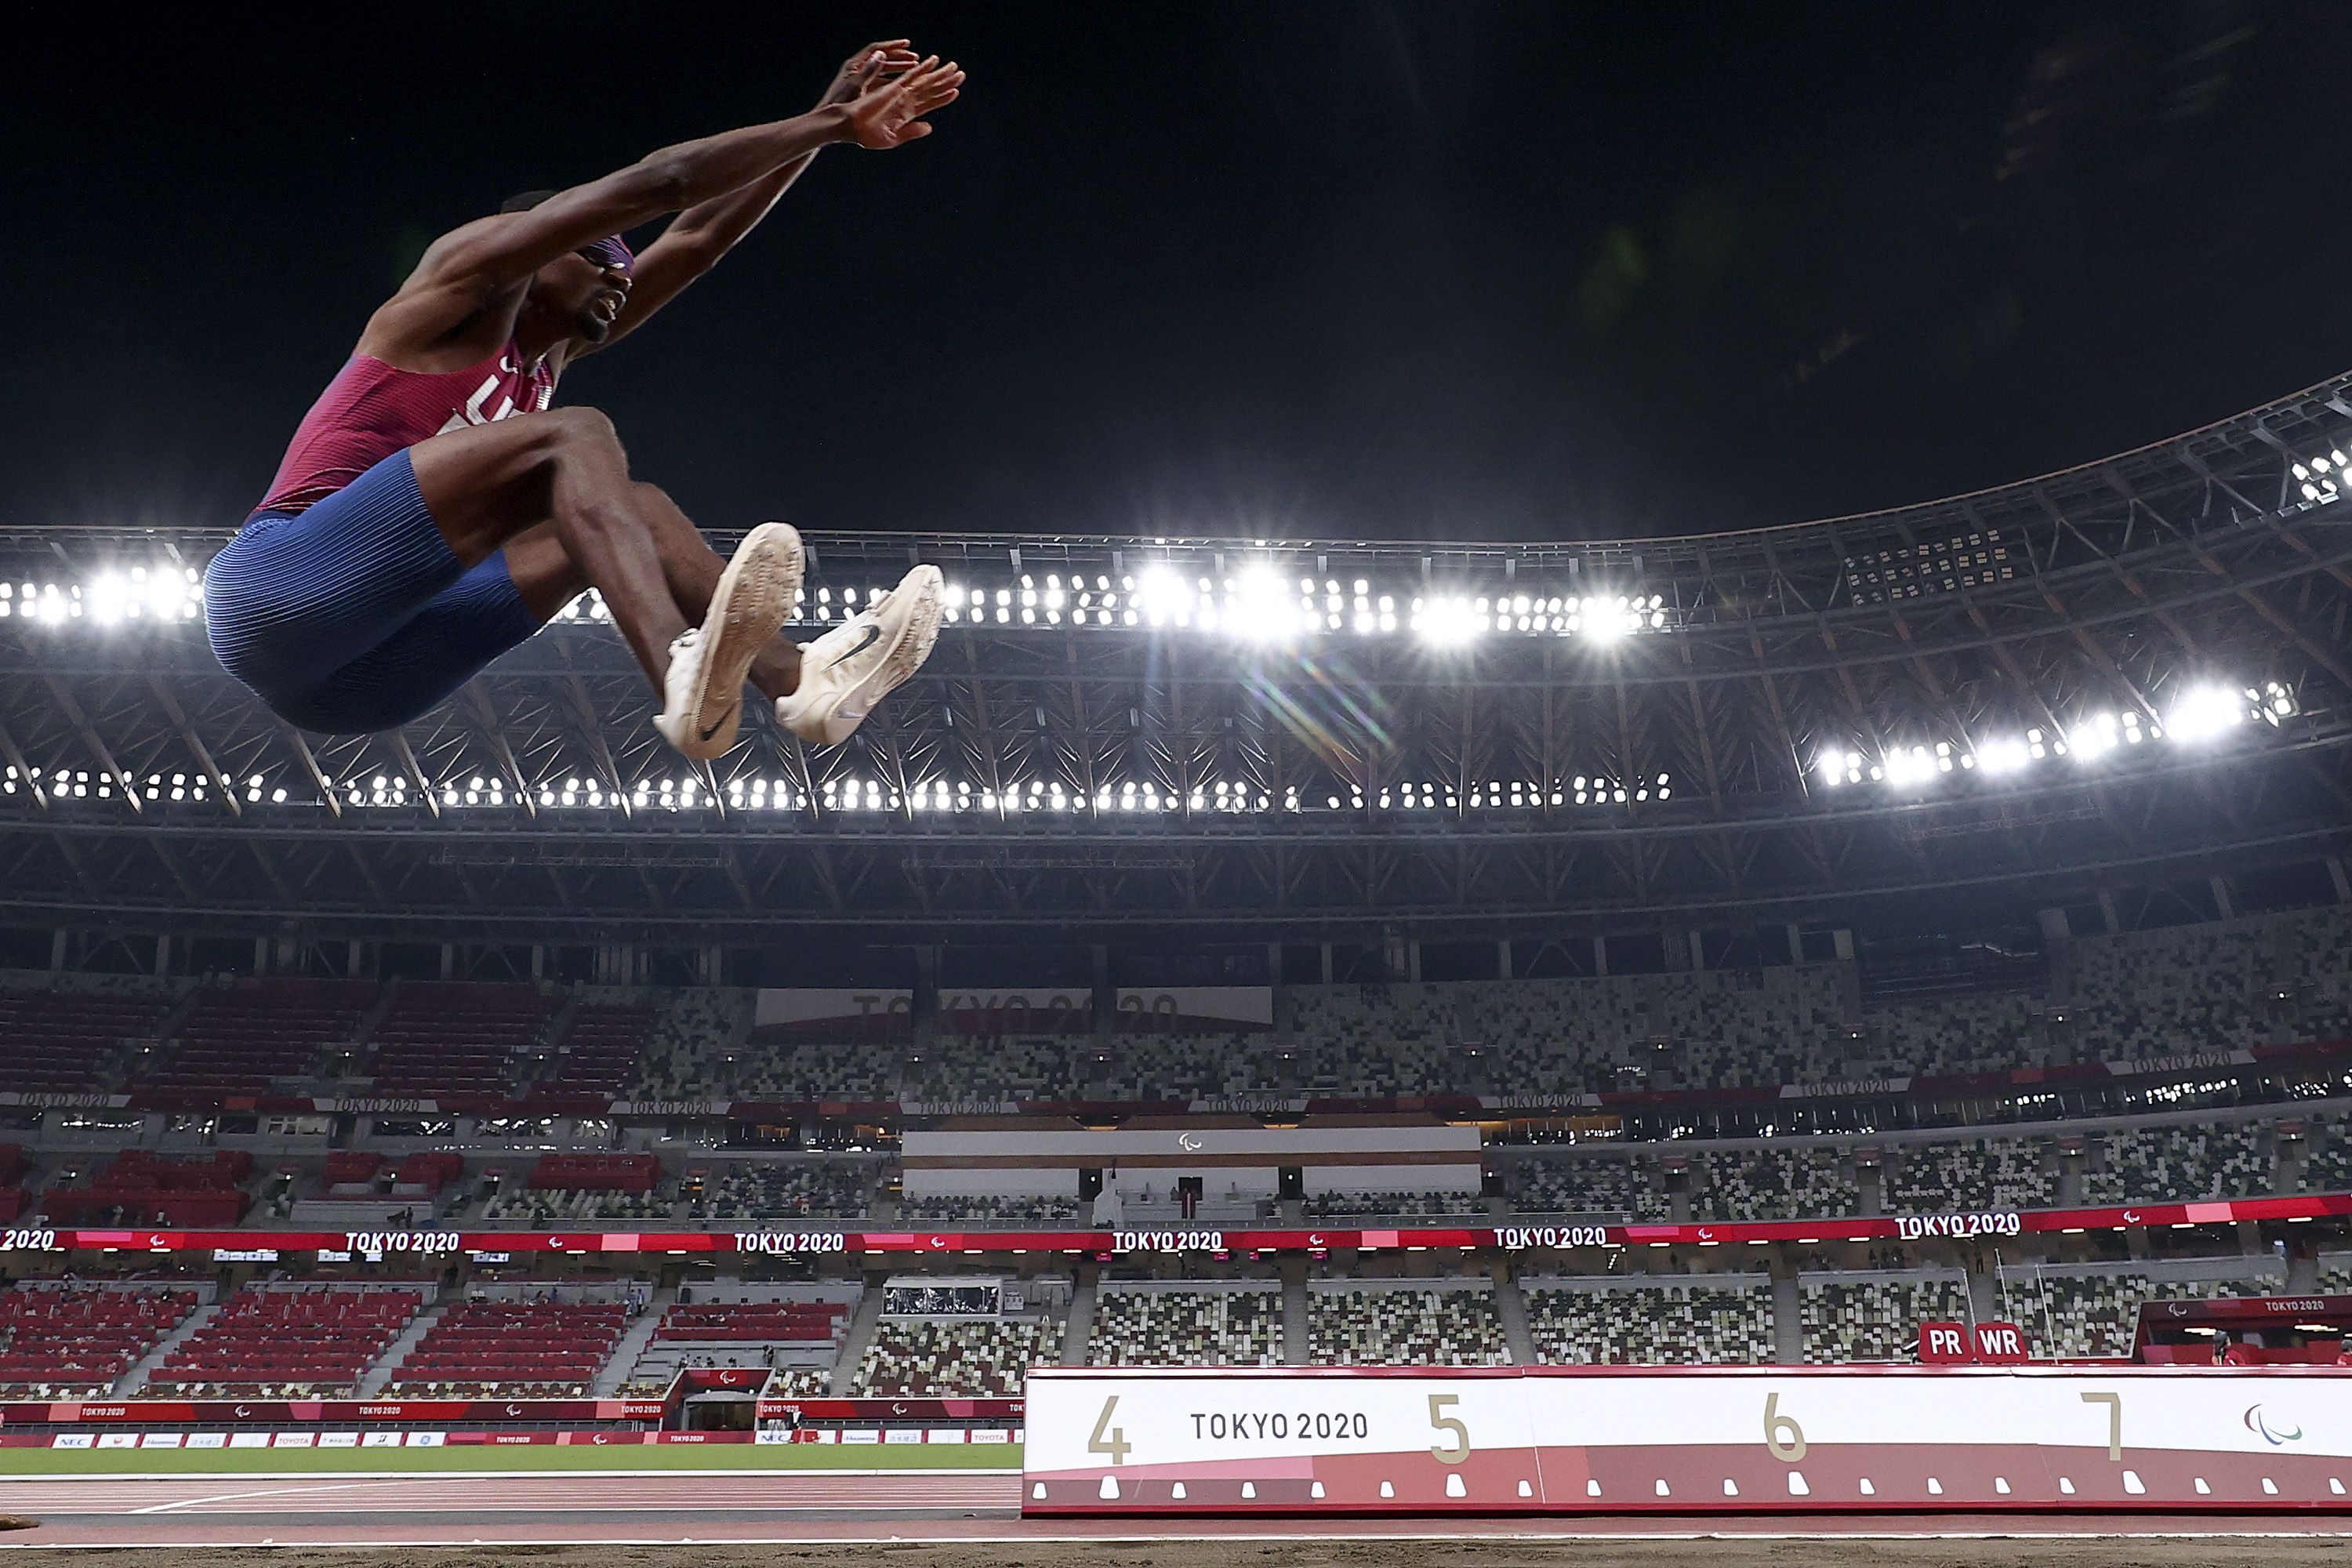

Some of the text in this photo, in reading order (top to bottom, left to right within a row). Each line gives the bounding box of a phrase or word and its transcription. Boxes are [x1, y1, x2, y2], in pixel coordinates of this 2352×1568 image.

[334, 1099, 419, 1112] TOKYO 2020
[628, 1102, 712, 1114] TOKYO 2020
[1894, 1213, 2020, 1237] TOKYO 2020
[2, 1229, 55, 1249] 2020
[346, 1232, 459, 1252] TOKYO 2020
[734, 1233, 844, 1252] TOKYO 2020
[1112, 1232, 1222, 1251] TOKYO 2020
[1493, 1227, 1606, 1247] TOKYO 2020
[2265, 1300, 2325, 1312] TOKYO 2020
[1930, 1330, 1963, 1355] PR
[1978, 1329, 2021, 1355] WR
[82, 1407, 125, 1417] TOKYO 2020
[359, 1406, 401, 1415] TOKYO 2020
[620, 1405, 662, 1414] TOKYO 2020
[760, 1404, 782, 1413] TOKYO
[1088, 1396, 1131, 1465] 4
[1190, 1413, 1368, 1439] TOKYO 2020
[1428, 1394, 1470, 1465] 5
[1764, 1392, 1807, 1463] 6
[2080, 1392, 2122, 1461] 7
[60, 1438, 89, 1446] NEC
